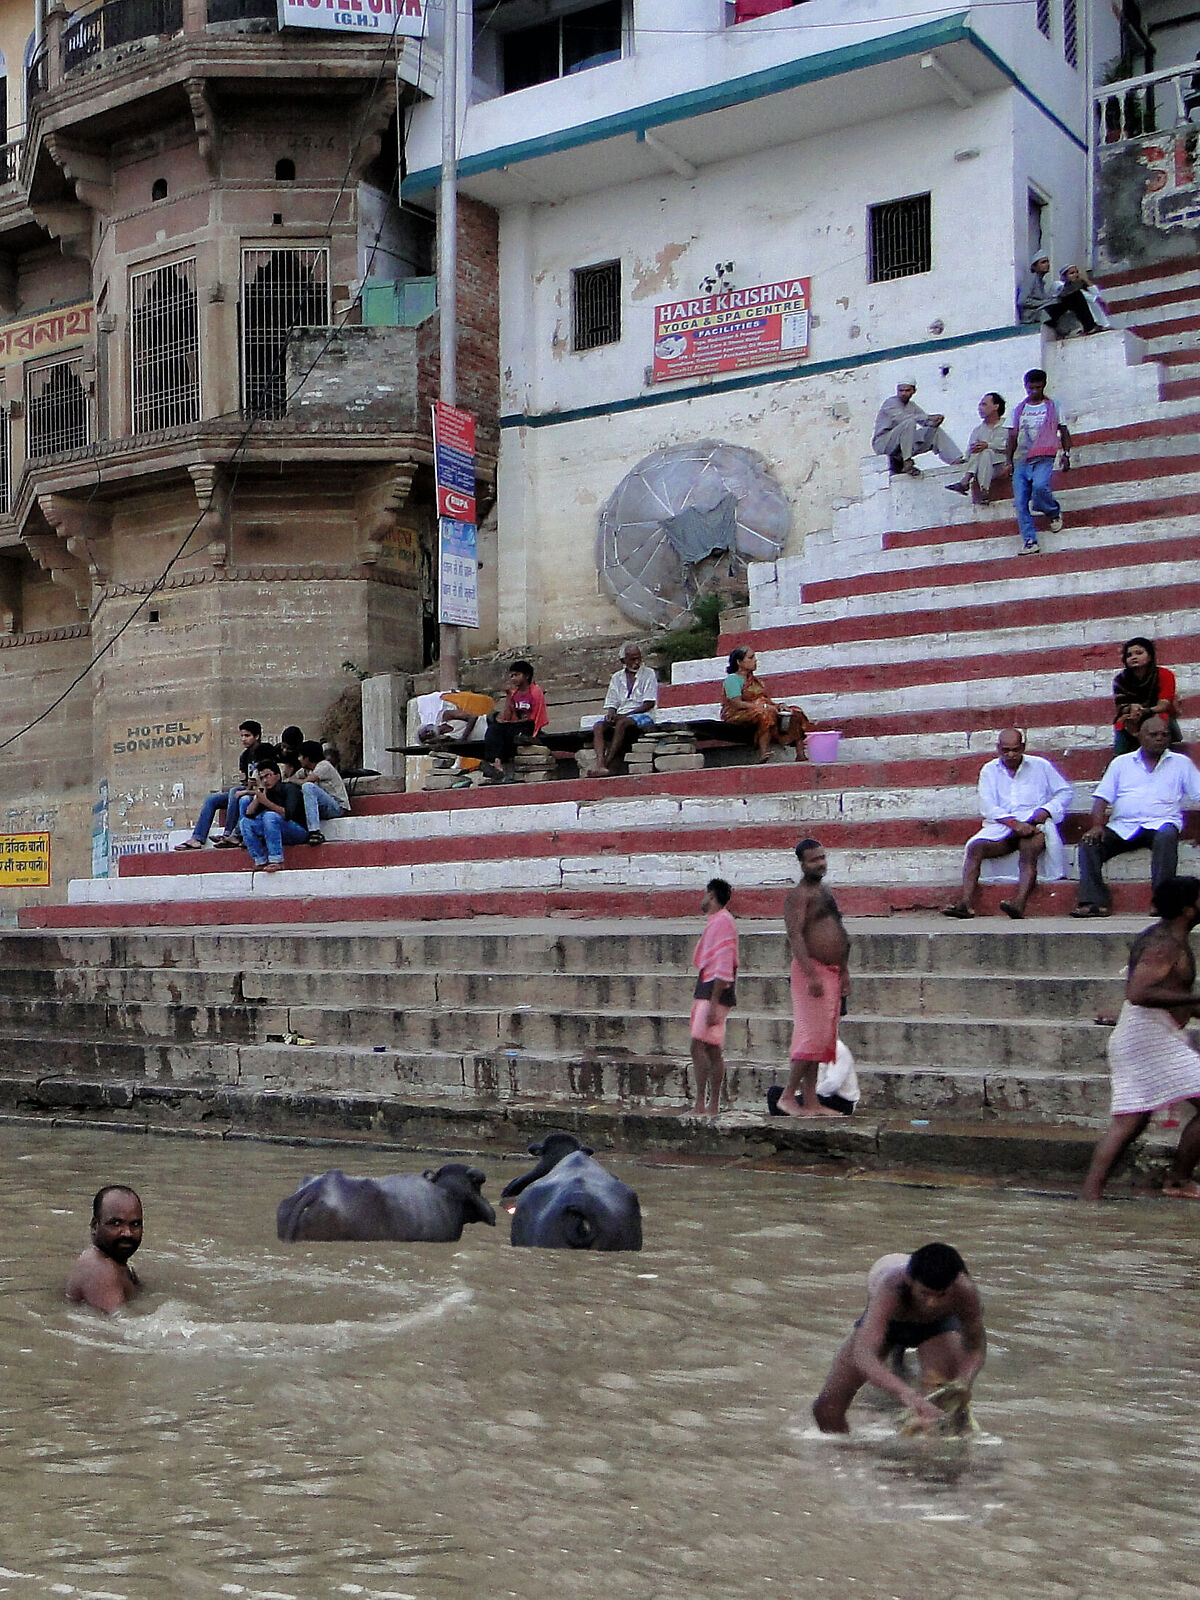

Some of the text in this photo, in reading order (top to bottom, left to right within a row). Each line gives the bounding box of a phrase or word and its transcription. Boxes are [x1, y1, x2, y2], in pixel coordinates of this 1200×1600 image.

[660, 281, 805, 322] HARE KRISHNA
[663, 301, 801, 333] YOGA & SPA CENTRE
[698, 320, 760, 337] FACILITIES
[127, 722, 191, 738] HOTEL
[113, 732, 205, 754] SONMONY
